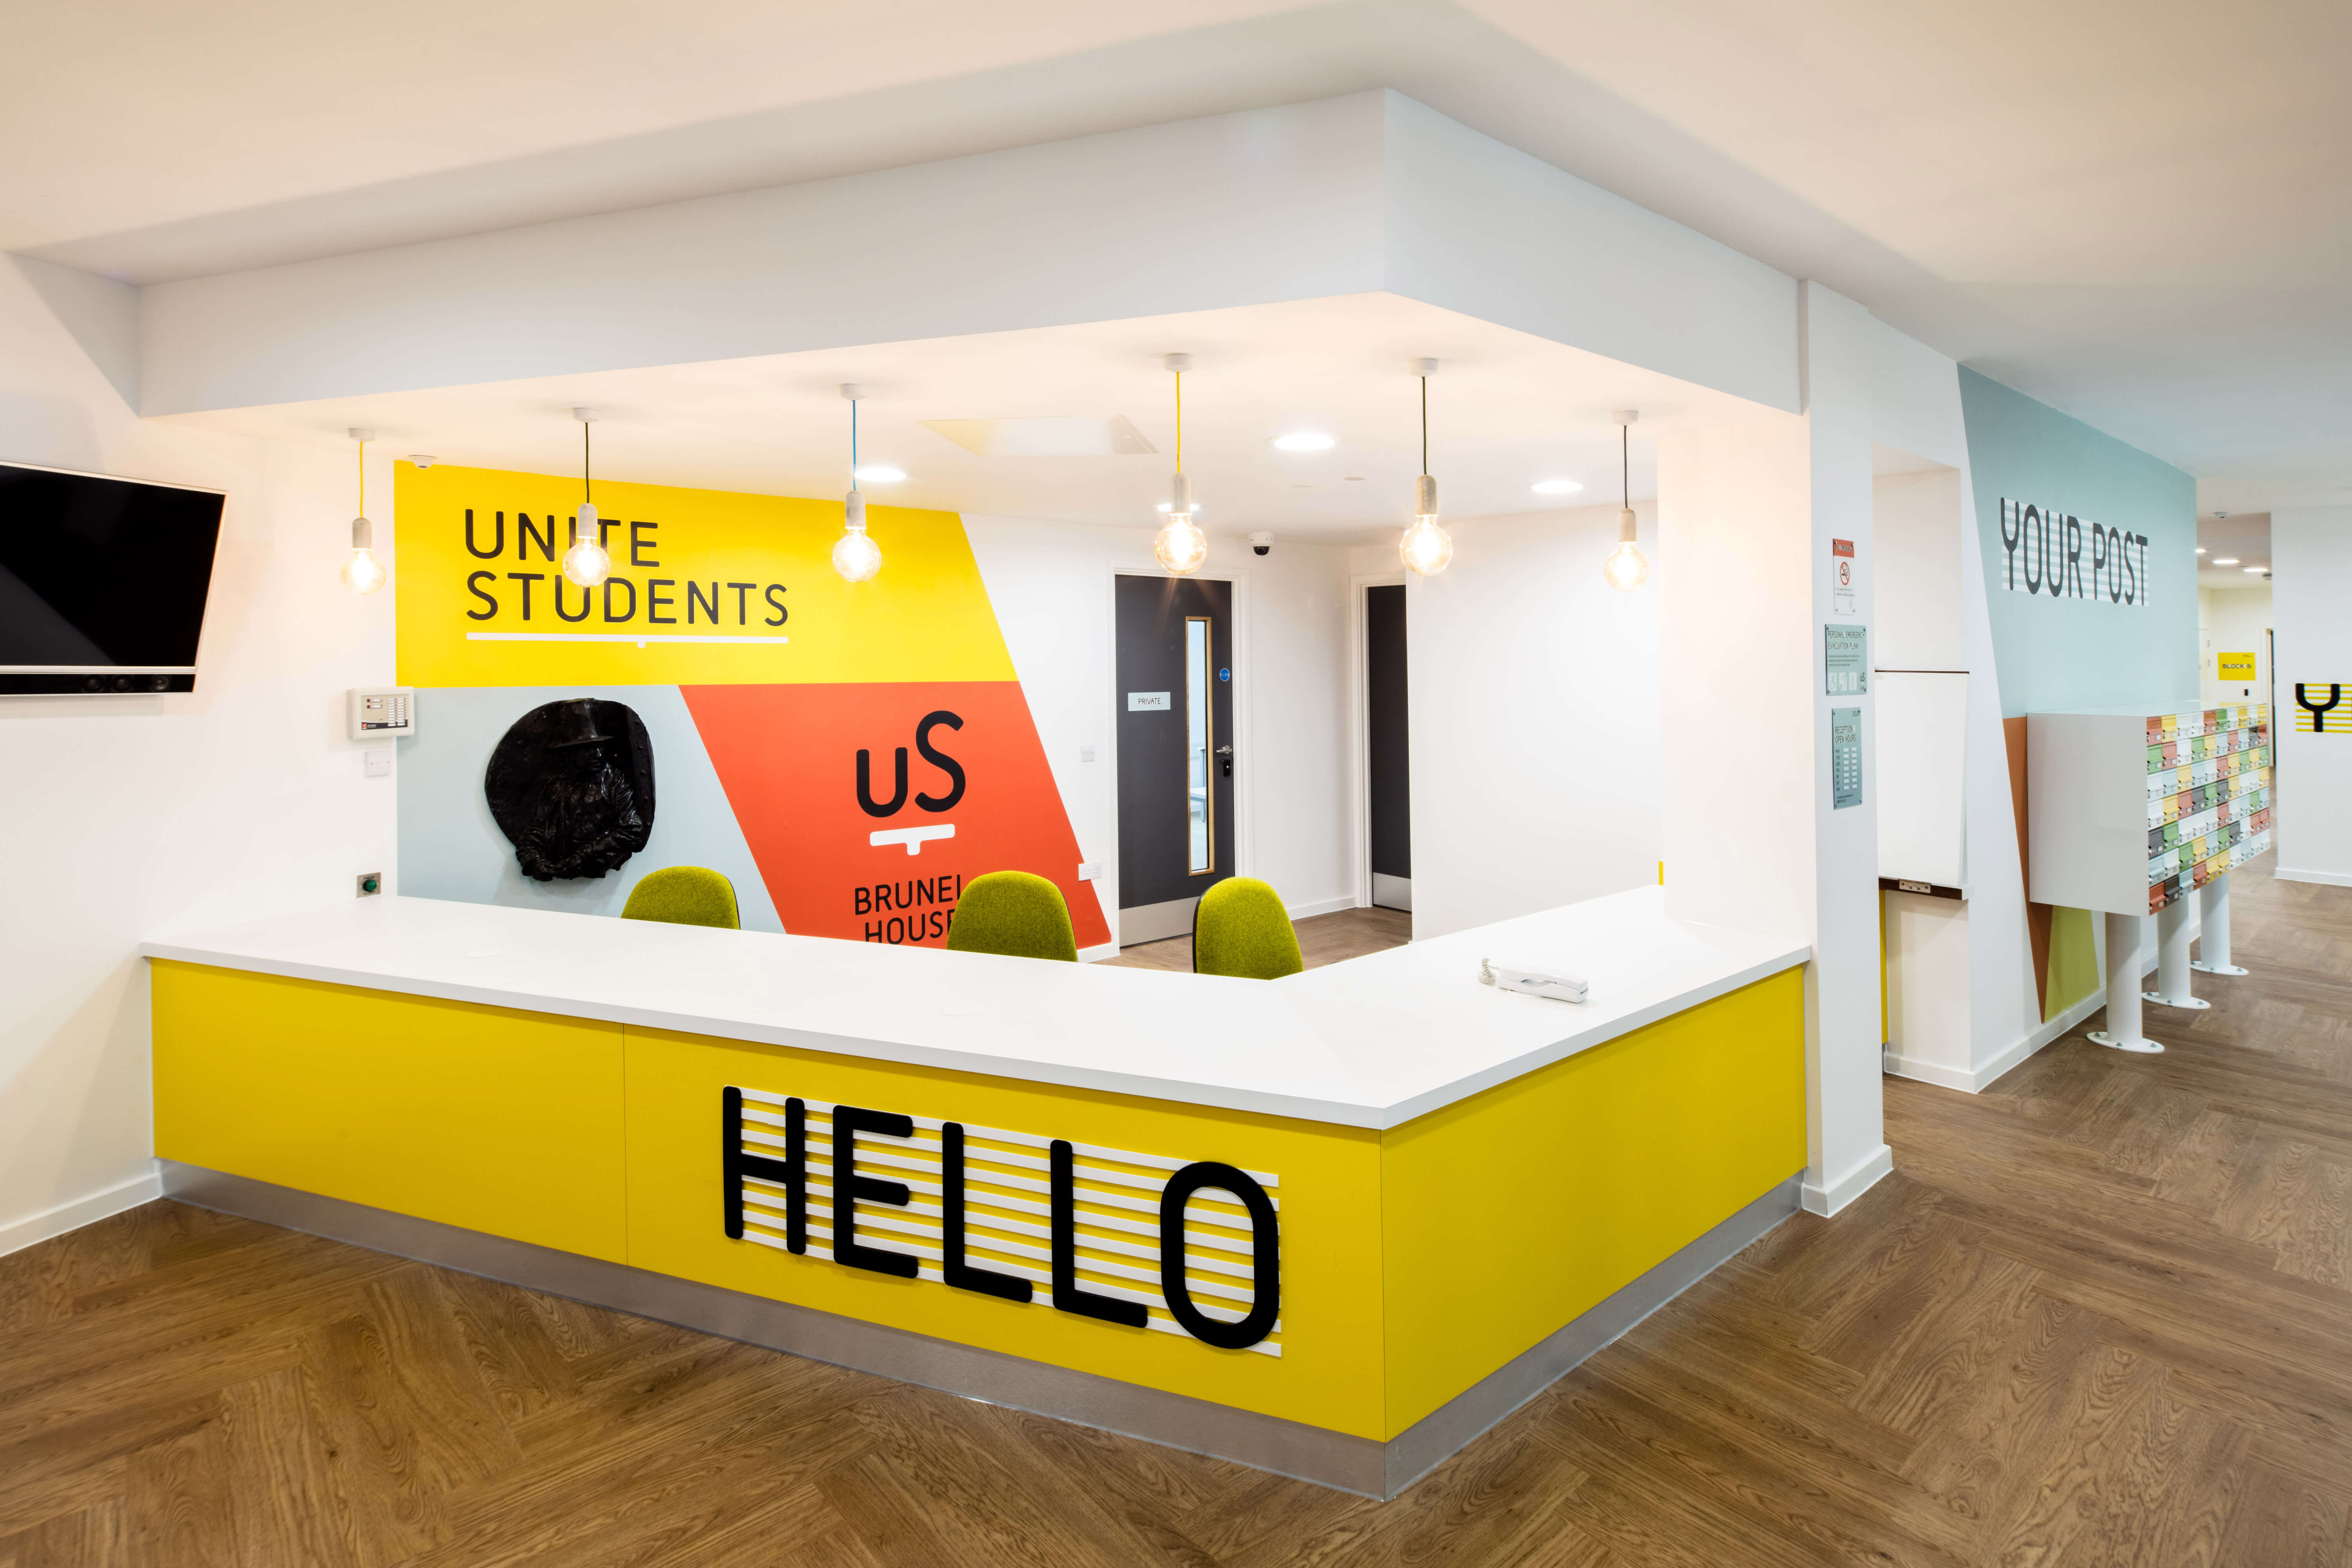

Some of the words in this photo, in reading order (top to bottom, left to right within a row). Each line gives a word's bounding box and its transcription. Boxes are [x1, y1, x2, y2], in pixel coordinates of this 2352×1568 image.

[465, 509, 659, 567] UNITE
[2000, 497, 2083, 599] YOUR
[2092, 522, 2148, 606] POST
[466, 570, 788, 626] STUDENTS
[1835, 725, 1853, 734] RECEPTION
[2295, 683, 2352, 732] Y
[1845, 734, 1856, 742] HOURS
[723, 1086, 1279, 1349] HELLO
